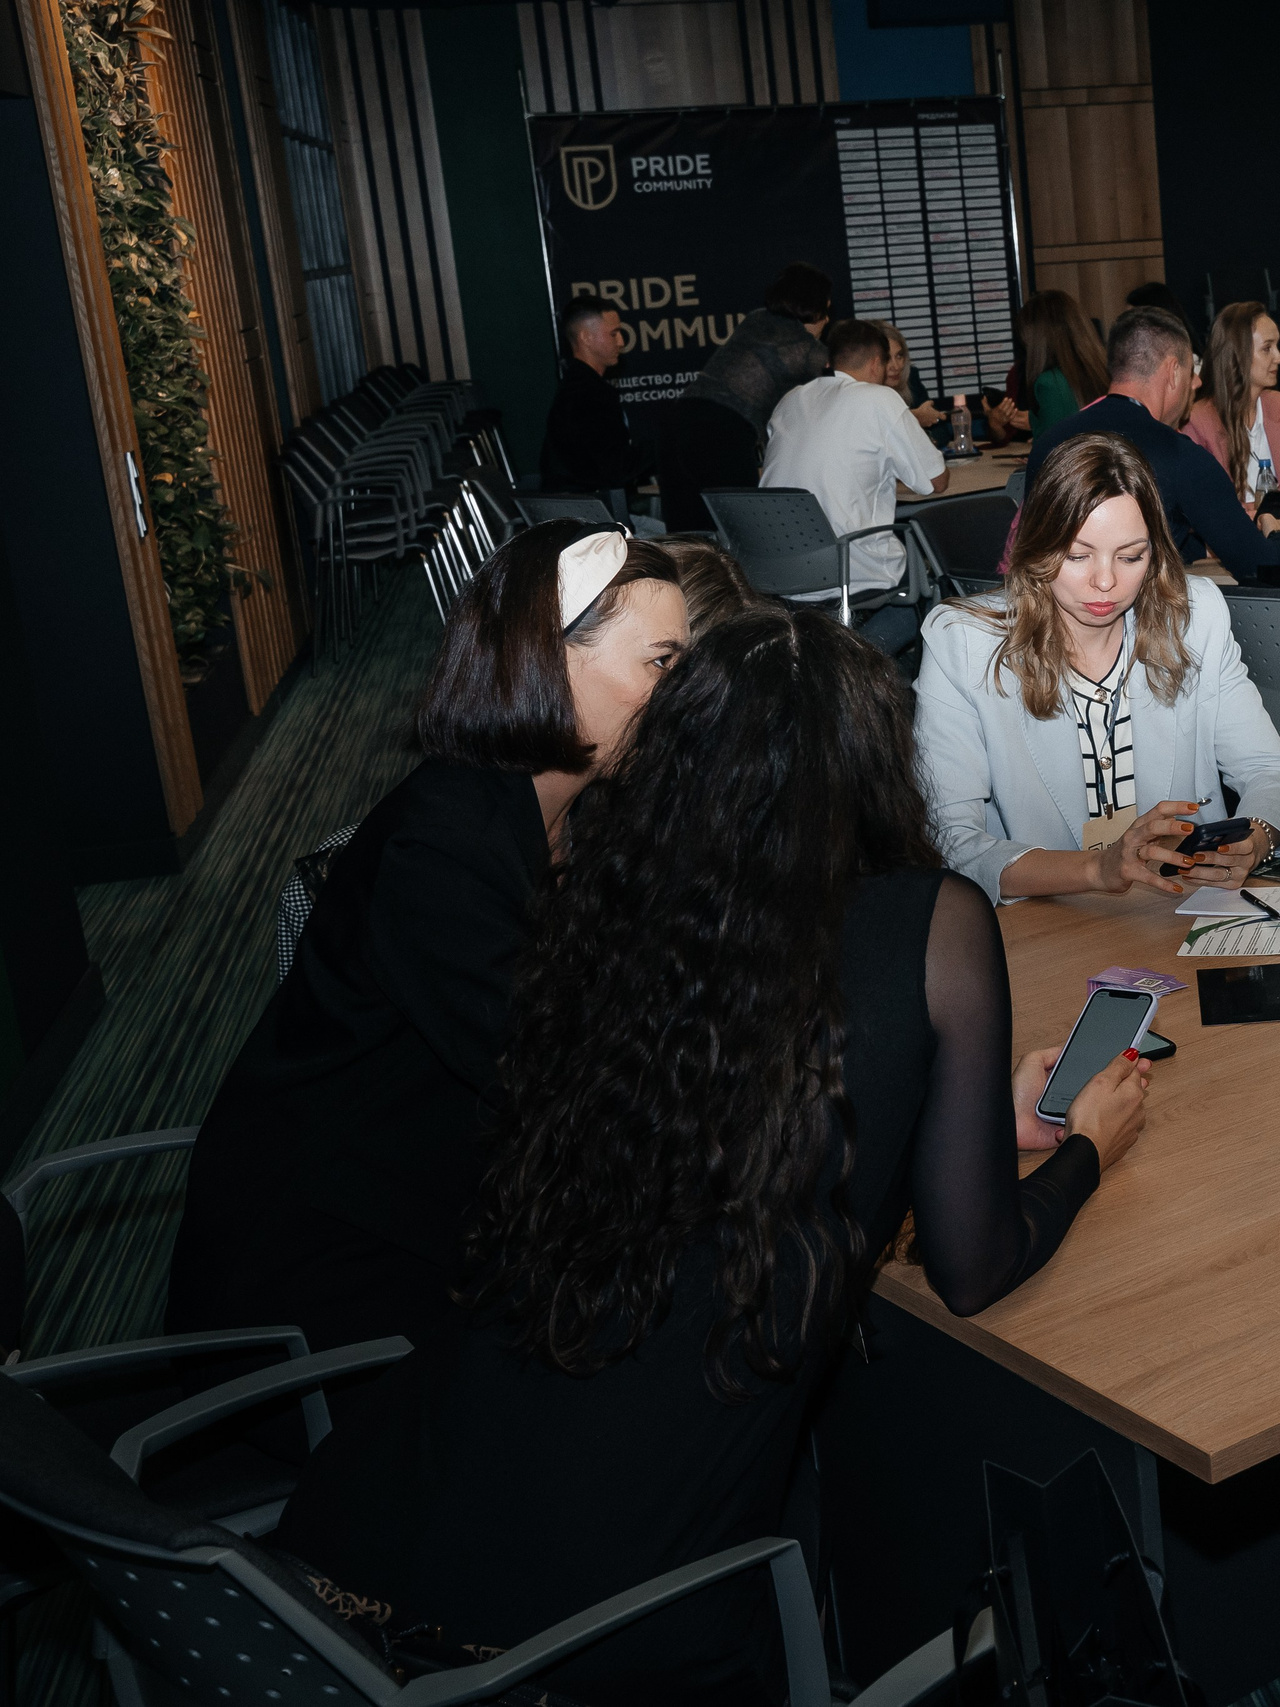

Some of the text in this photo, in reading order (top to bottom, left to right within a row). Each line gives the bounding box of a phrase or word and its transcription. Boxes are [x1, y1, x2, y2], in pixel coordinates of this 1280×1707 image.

[631, 154, 712, 178] PRIDE
[633, 178, 713, 193] COMMUNITY
[571, 274, 700, 311] PRIDE
[619, 313, 747, 354] OMMU
[619, 388, 684, 403] ФЕССИОН
